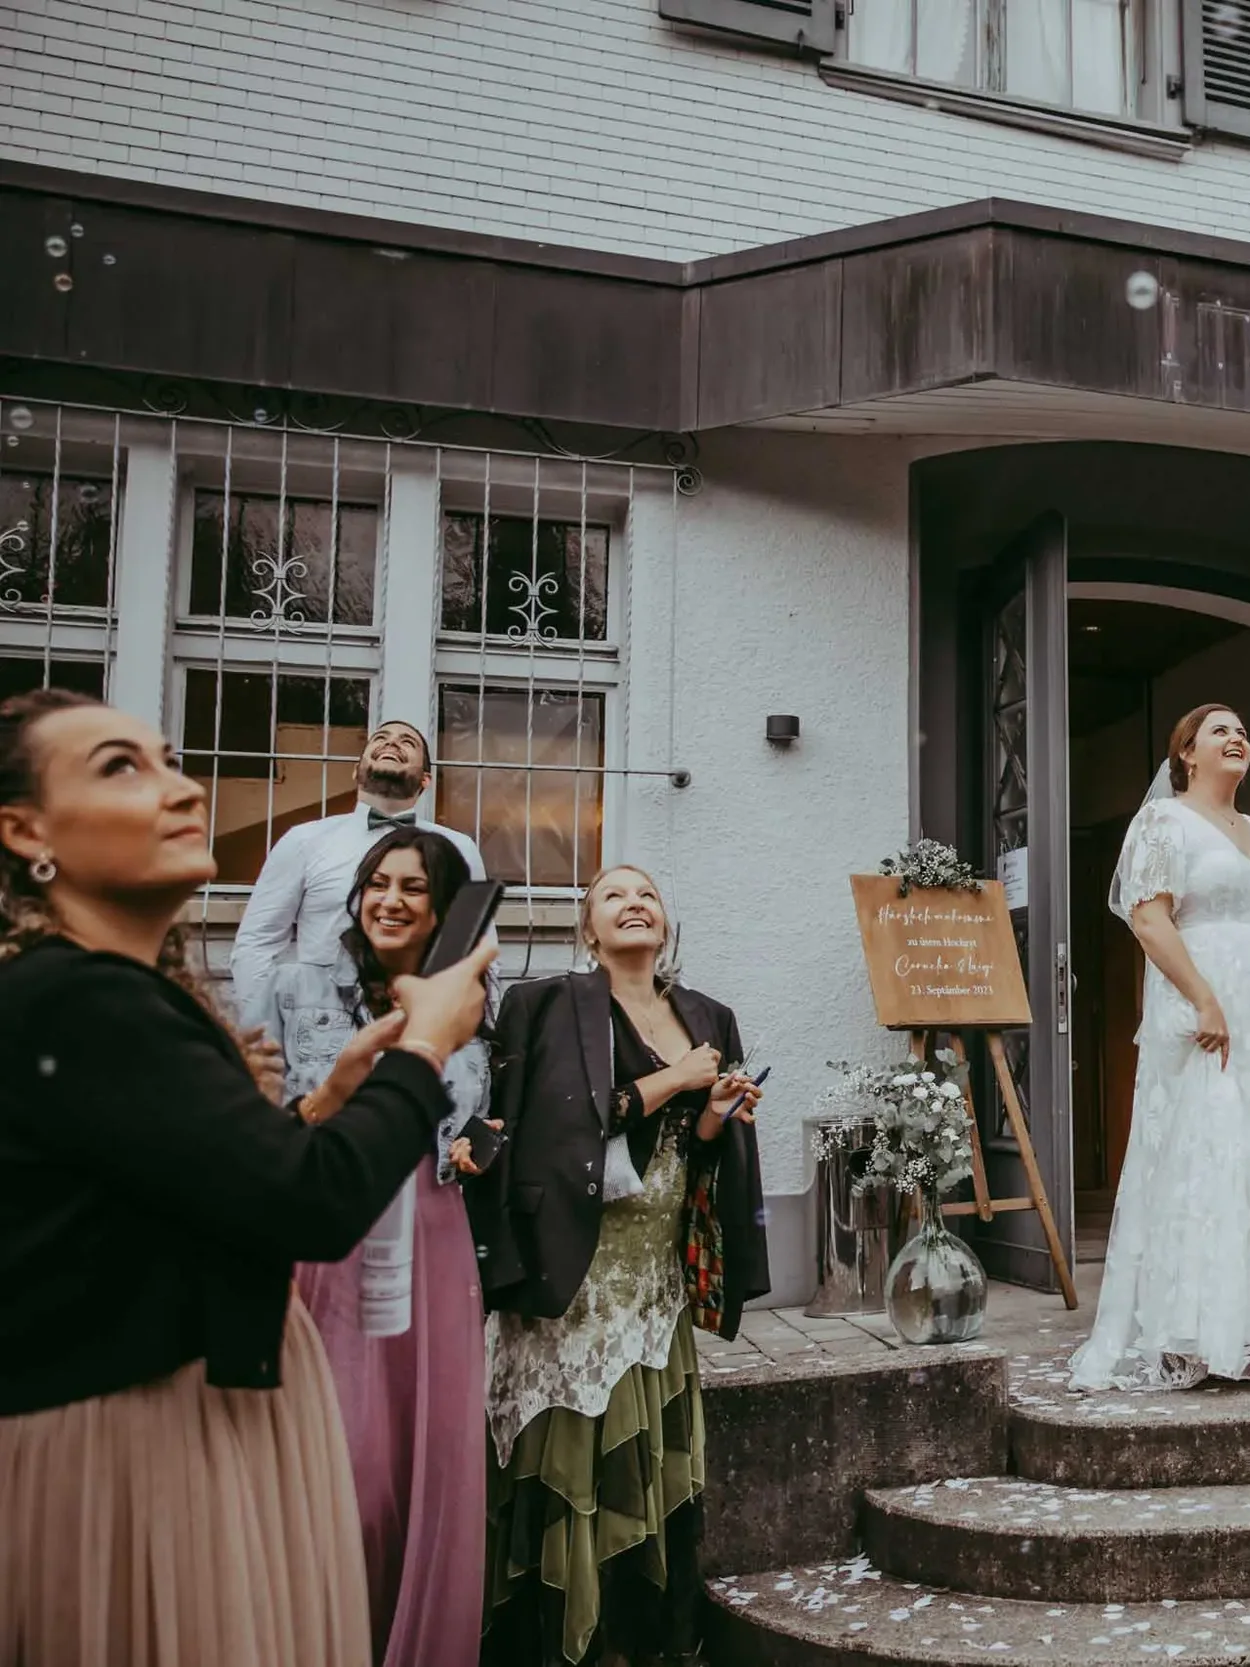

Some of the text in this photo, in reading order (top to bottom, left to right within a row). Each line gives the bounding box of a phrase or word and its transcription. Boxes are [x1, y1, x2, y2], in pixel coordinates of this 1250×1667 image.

[895, 954, 952, 976] Cornelia
[926, 985, 970, 998] September
[972, 985, 993, 995] 2023
